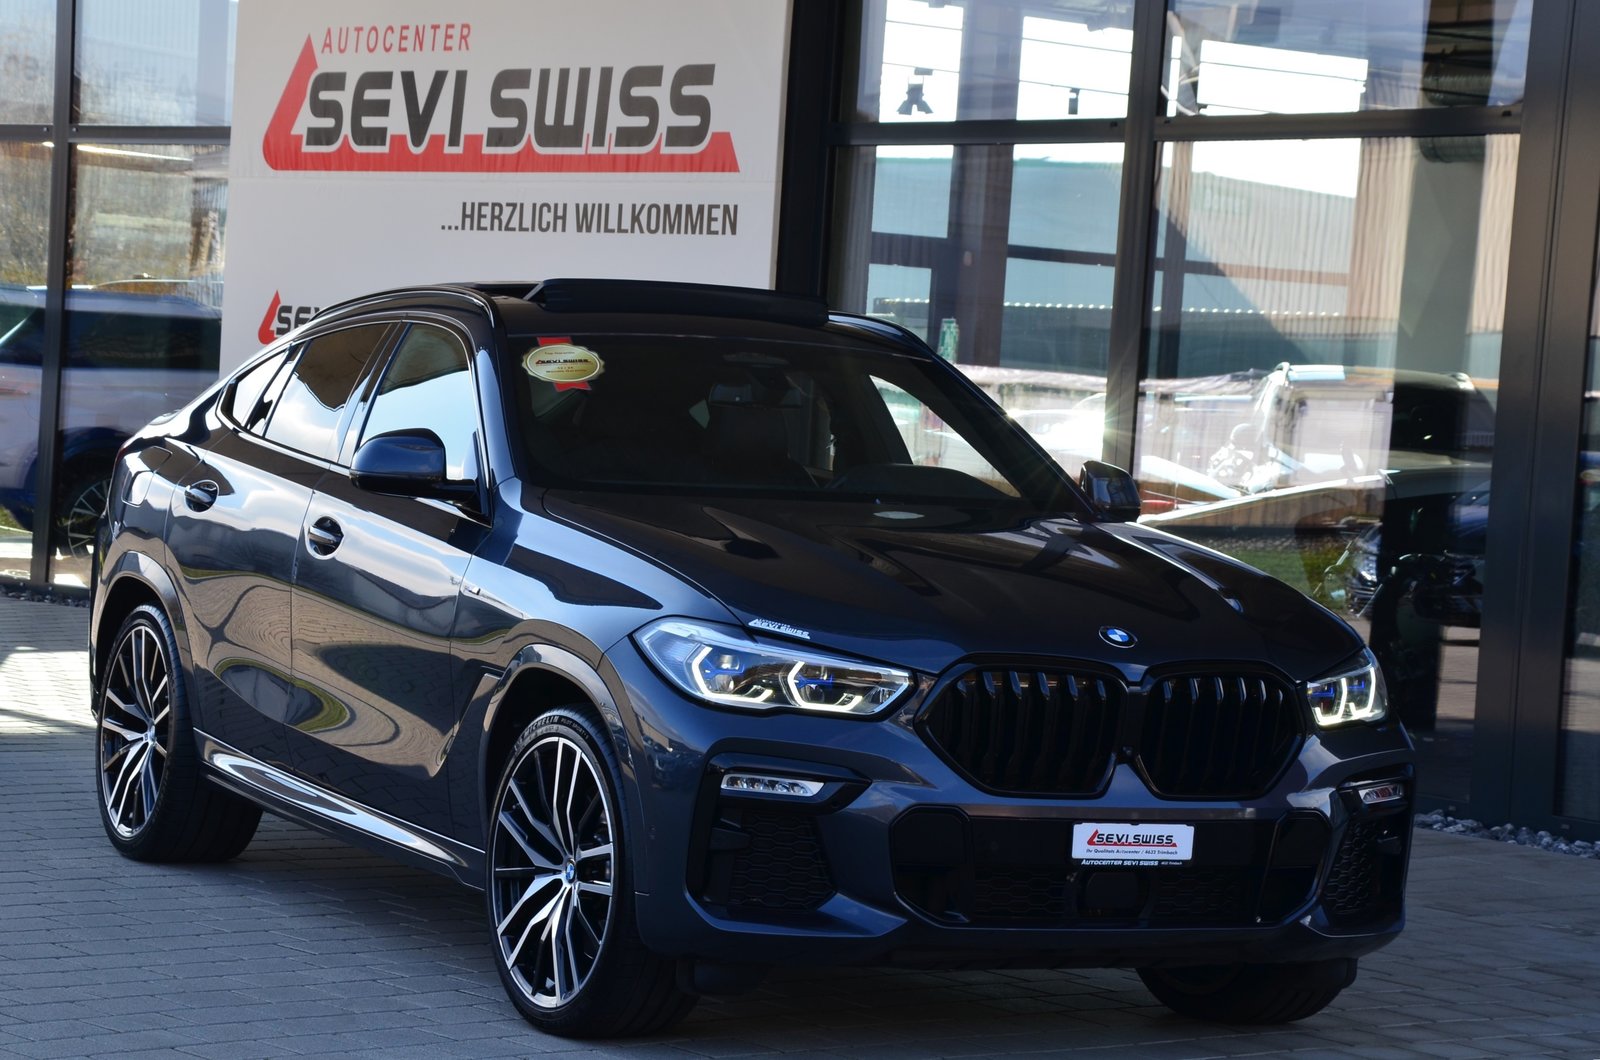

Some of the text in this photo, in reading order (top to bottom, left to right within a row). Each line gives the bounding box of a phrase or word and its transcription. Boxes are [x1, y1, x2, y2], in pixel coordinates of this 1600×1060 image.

[321, 23, 471, 54] AUTOCENTER
[304, 63, 716, 150] SEVI SWISS
[440, 202, 738, 235] ...HERZLICH WILLKOMMEN
[275, 305, 320, 336] SE
[523, 715, 560, 739] MICHELIN
[1096, 833, 1174, 845] SEVI SWISS
